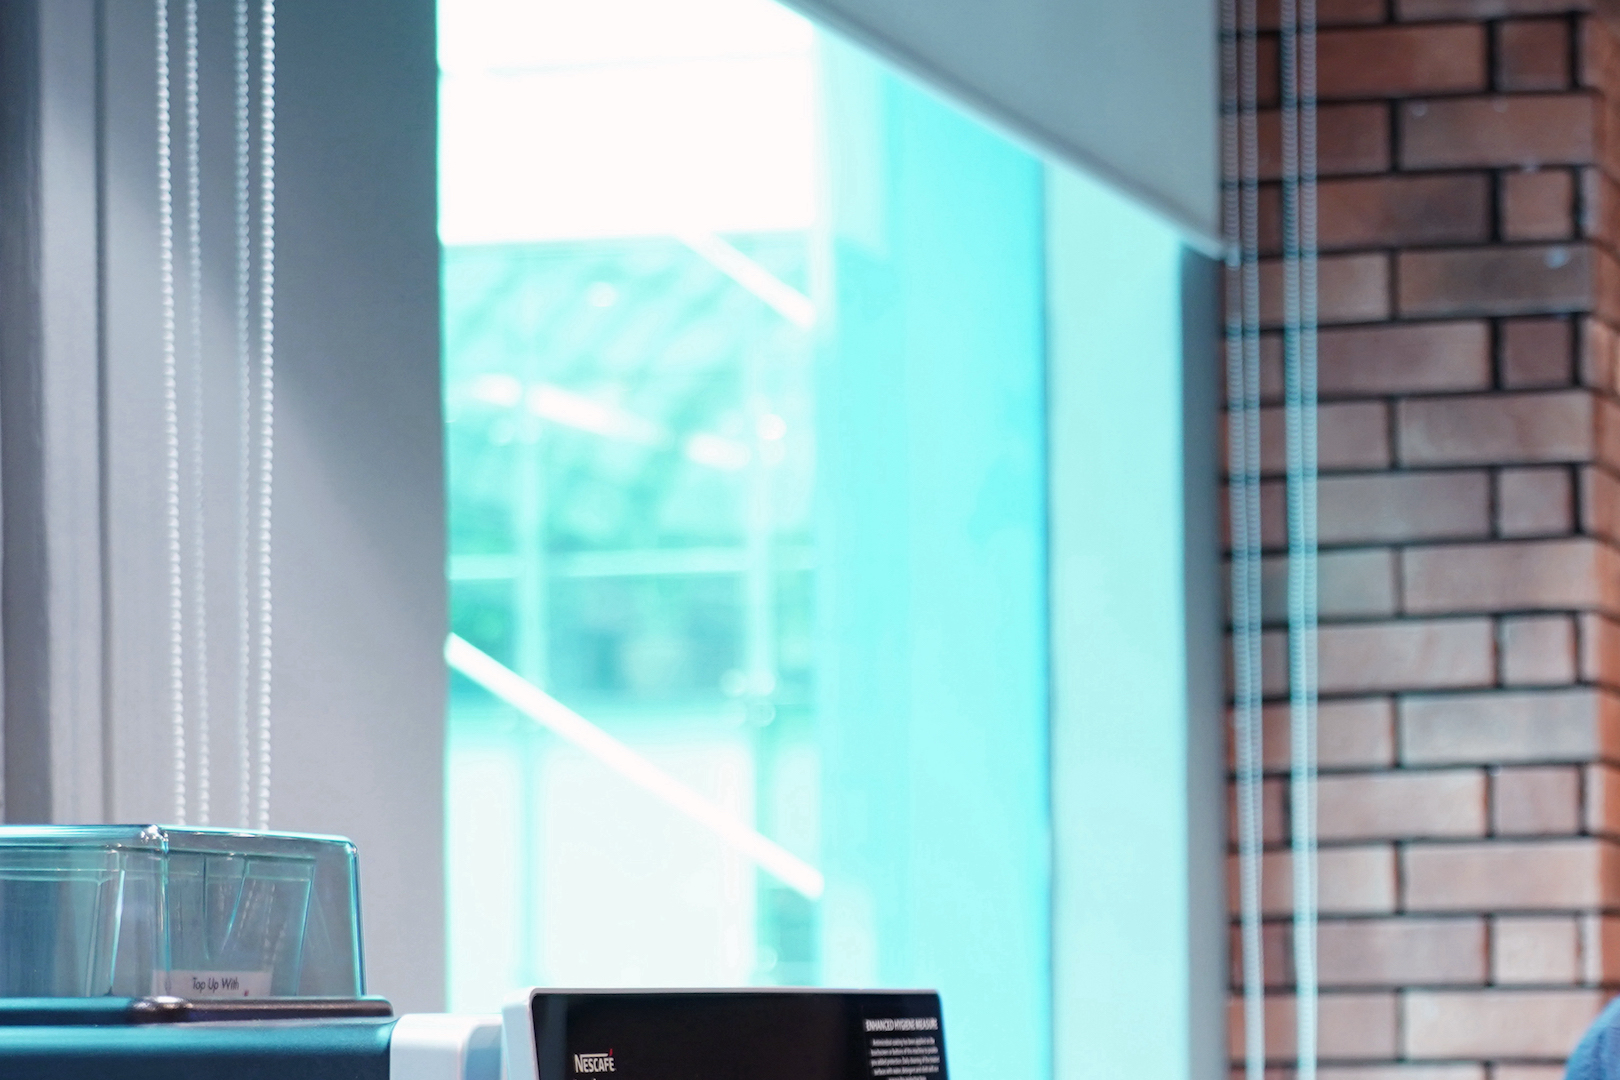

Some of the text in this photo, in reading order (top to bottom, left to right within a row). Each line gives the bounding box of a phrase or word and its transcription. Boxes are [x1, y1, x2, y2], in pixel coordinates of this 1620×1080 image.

[193, 977, 240, 994] Top Up With
[574, 1048, 617, 1073] NESCAFÉ
